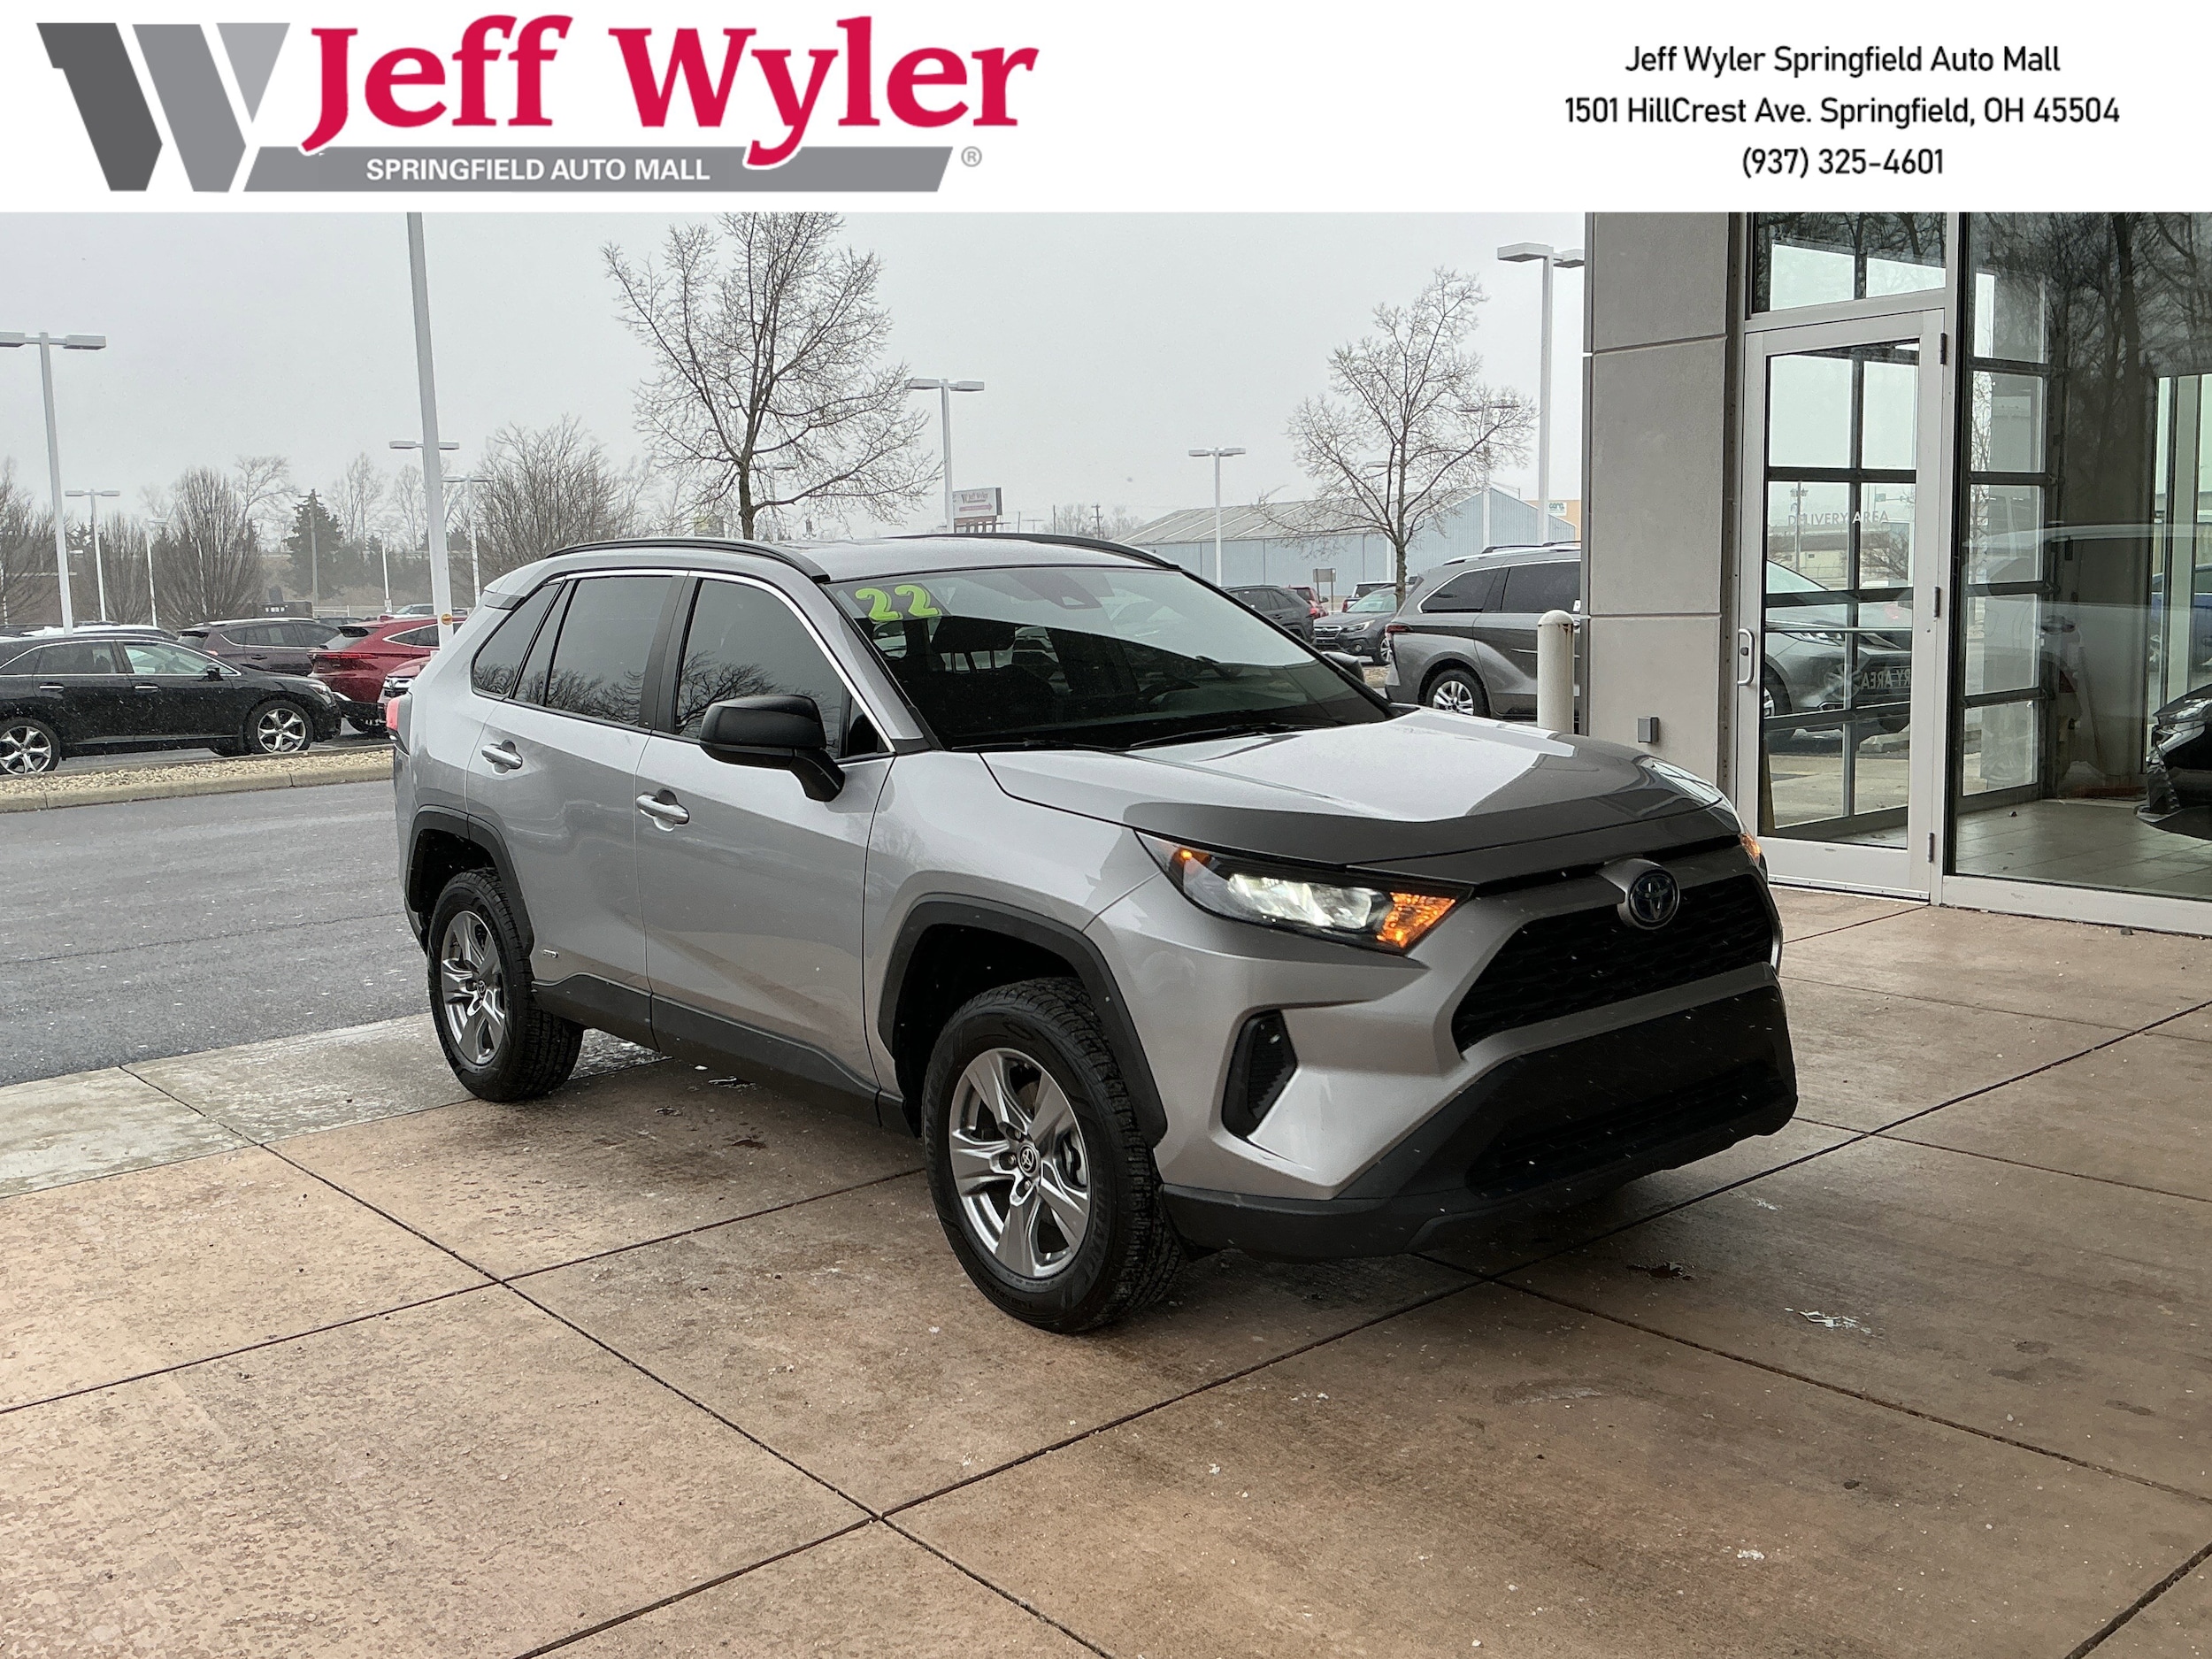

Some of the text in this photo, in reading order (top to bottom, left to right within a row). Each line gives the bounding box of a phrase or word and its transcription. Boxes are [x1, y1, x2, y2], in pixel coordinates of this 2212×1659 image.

[1788, 510, 1889, 526] DELIVERY AREA
[856, 584, 942, 622] 22
